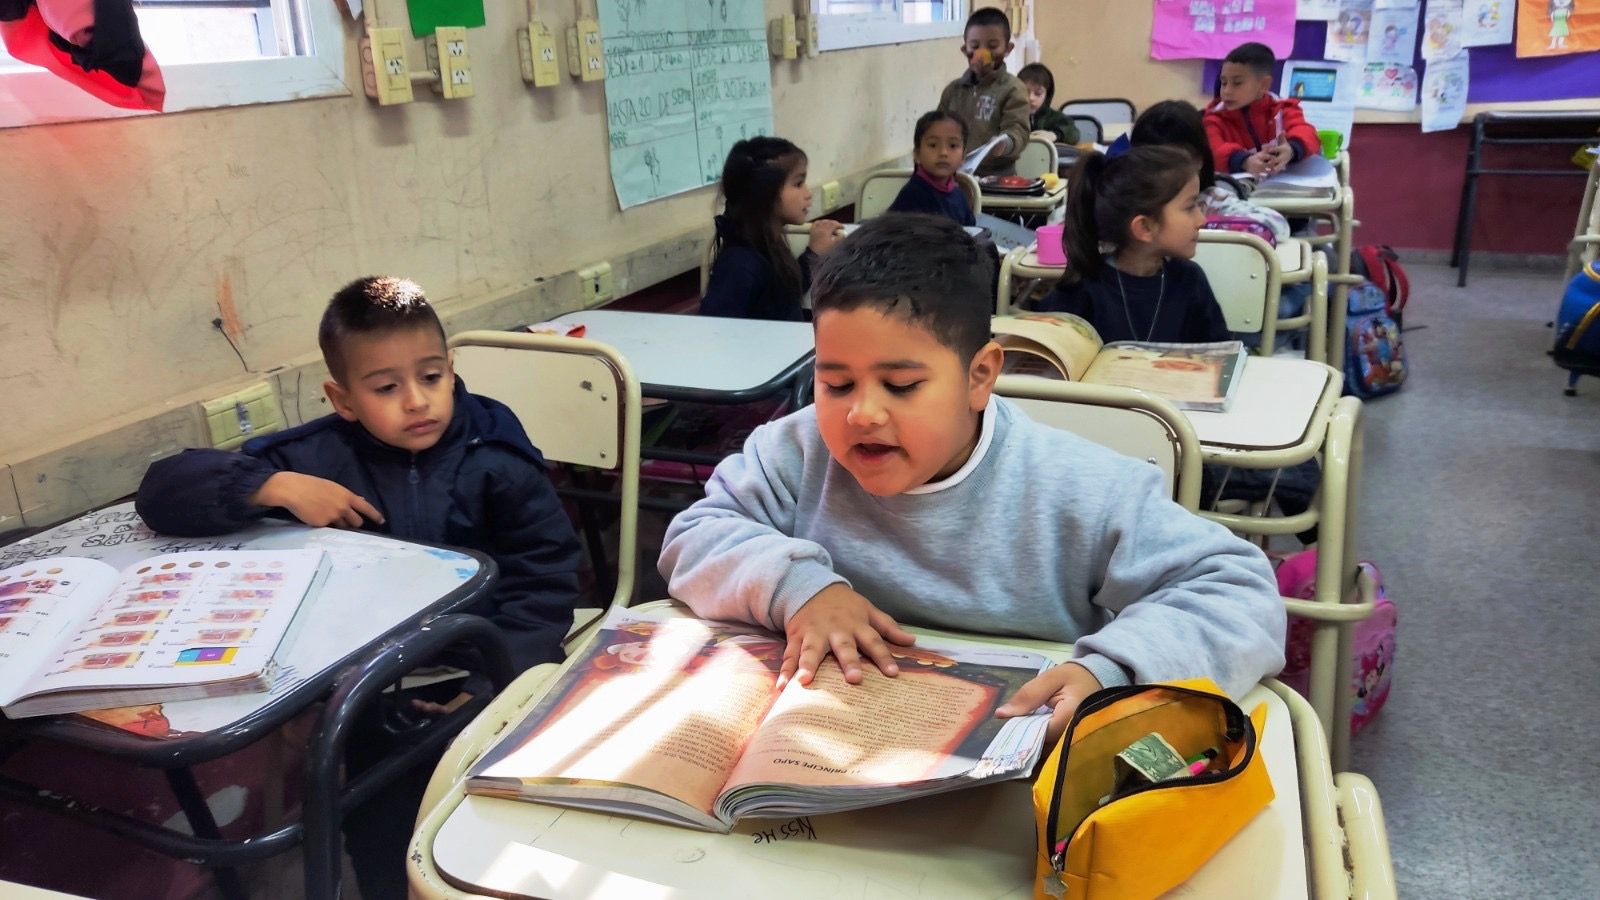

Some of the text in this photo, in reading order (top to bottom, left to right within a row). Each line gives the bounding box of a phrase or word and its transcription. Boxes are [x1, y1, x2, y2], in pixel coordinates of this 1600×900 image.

[608, 97, 639, 126] HASTA
[773, 758, 800, 766] SAPO
[802, 763, 847, 774] PRÍNCIPE
